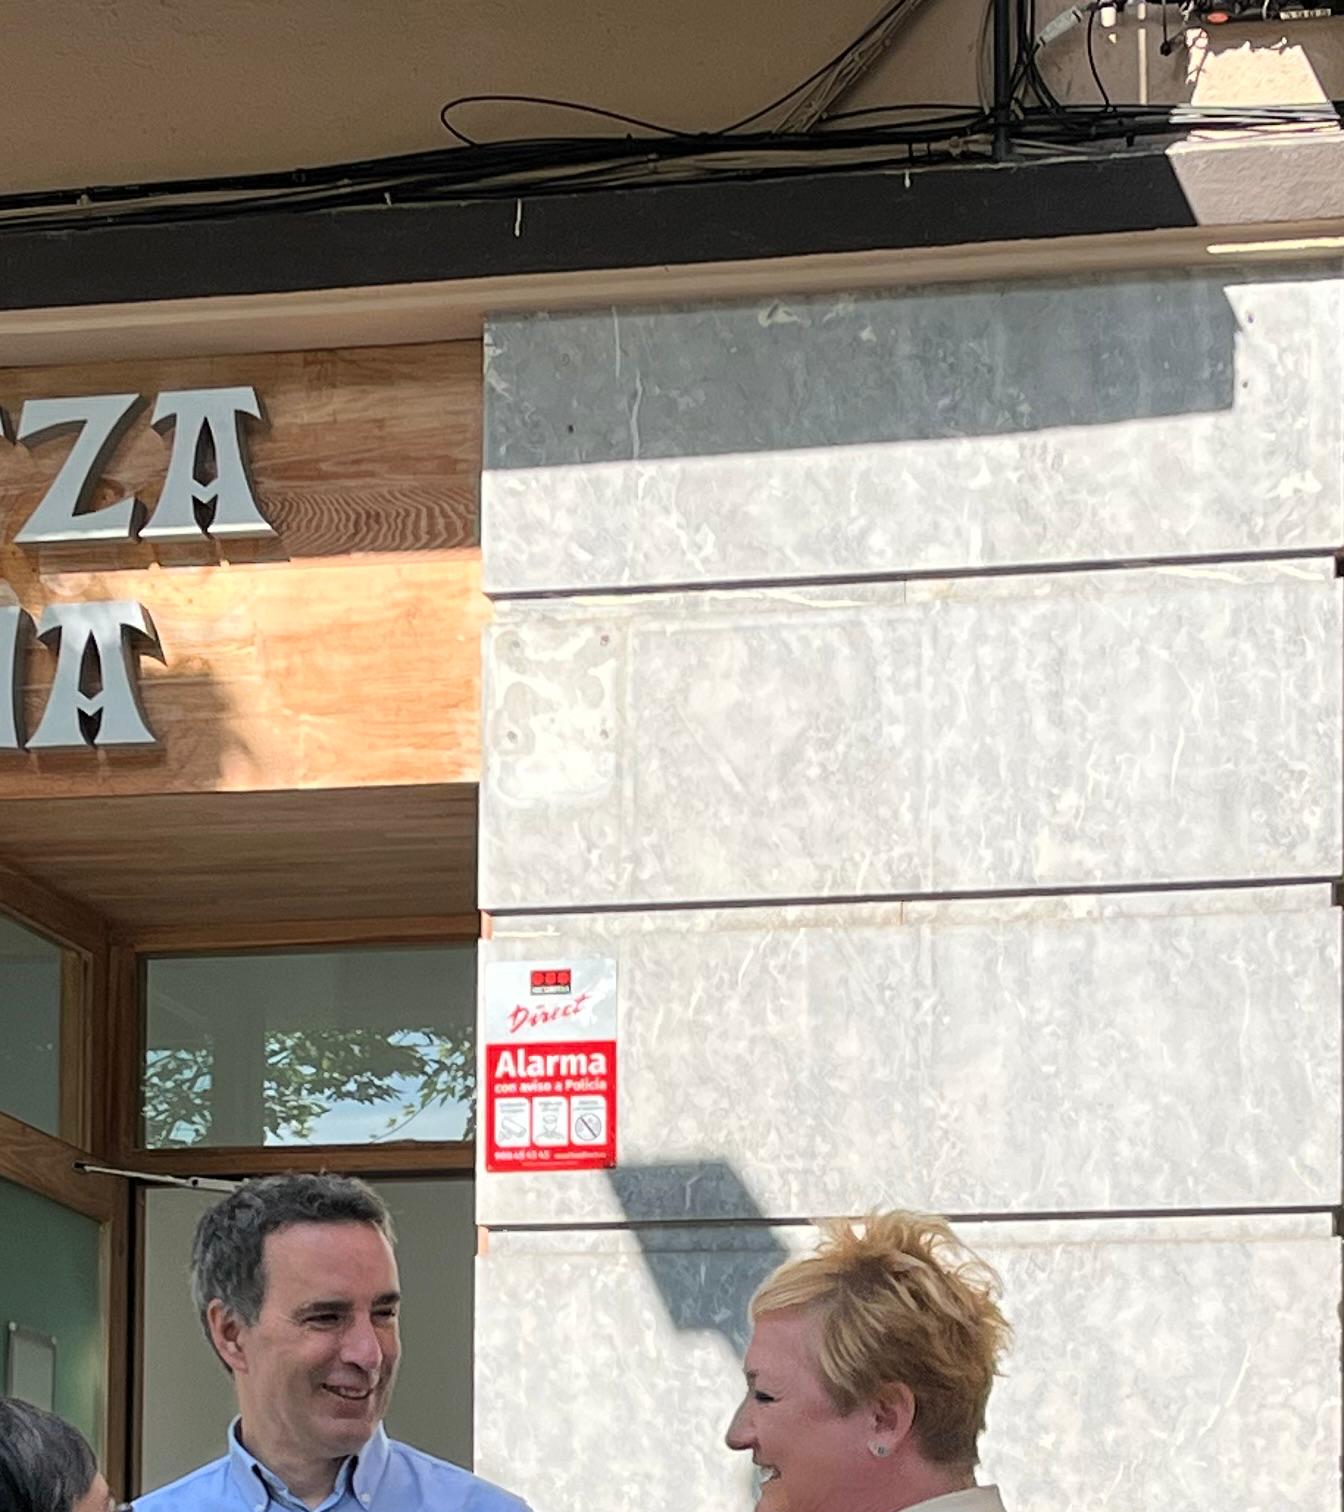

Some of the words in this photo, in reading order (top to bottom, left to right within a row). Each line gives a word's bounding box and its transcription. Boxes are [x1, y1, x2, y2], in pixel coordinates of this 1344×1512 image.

[508, 993, 591, 1033] Direct
[494, 1048, 607, 1078] Alarma
[494, 1082, 517, 1094] con
